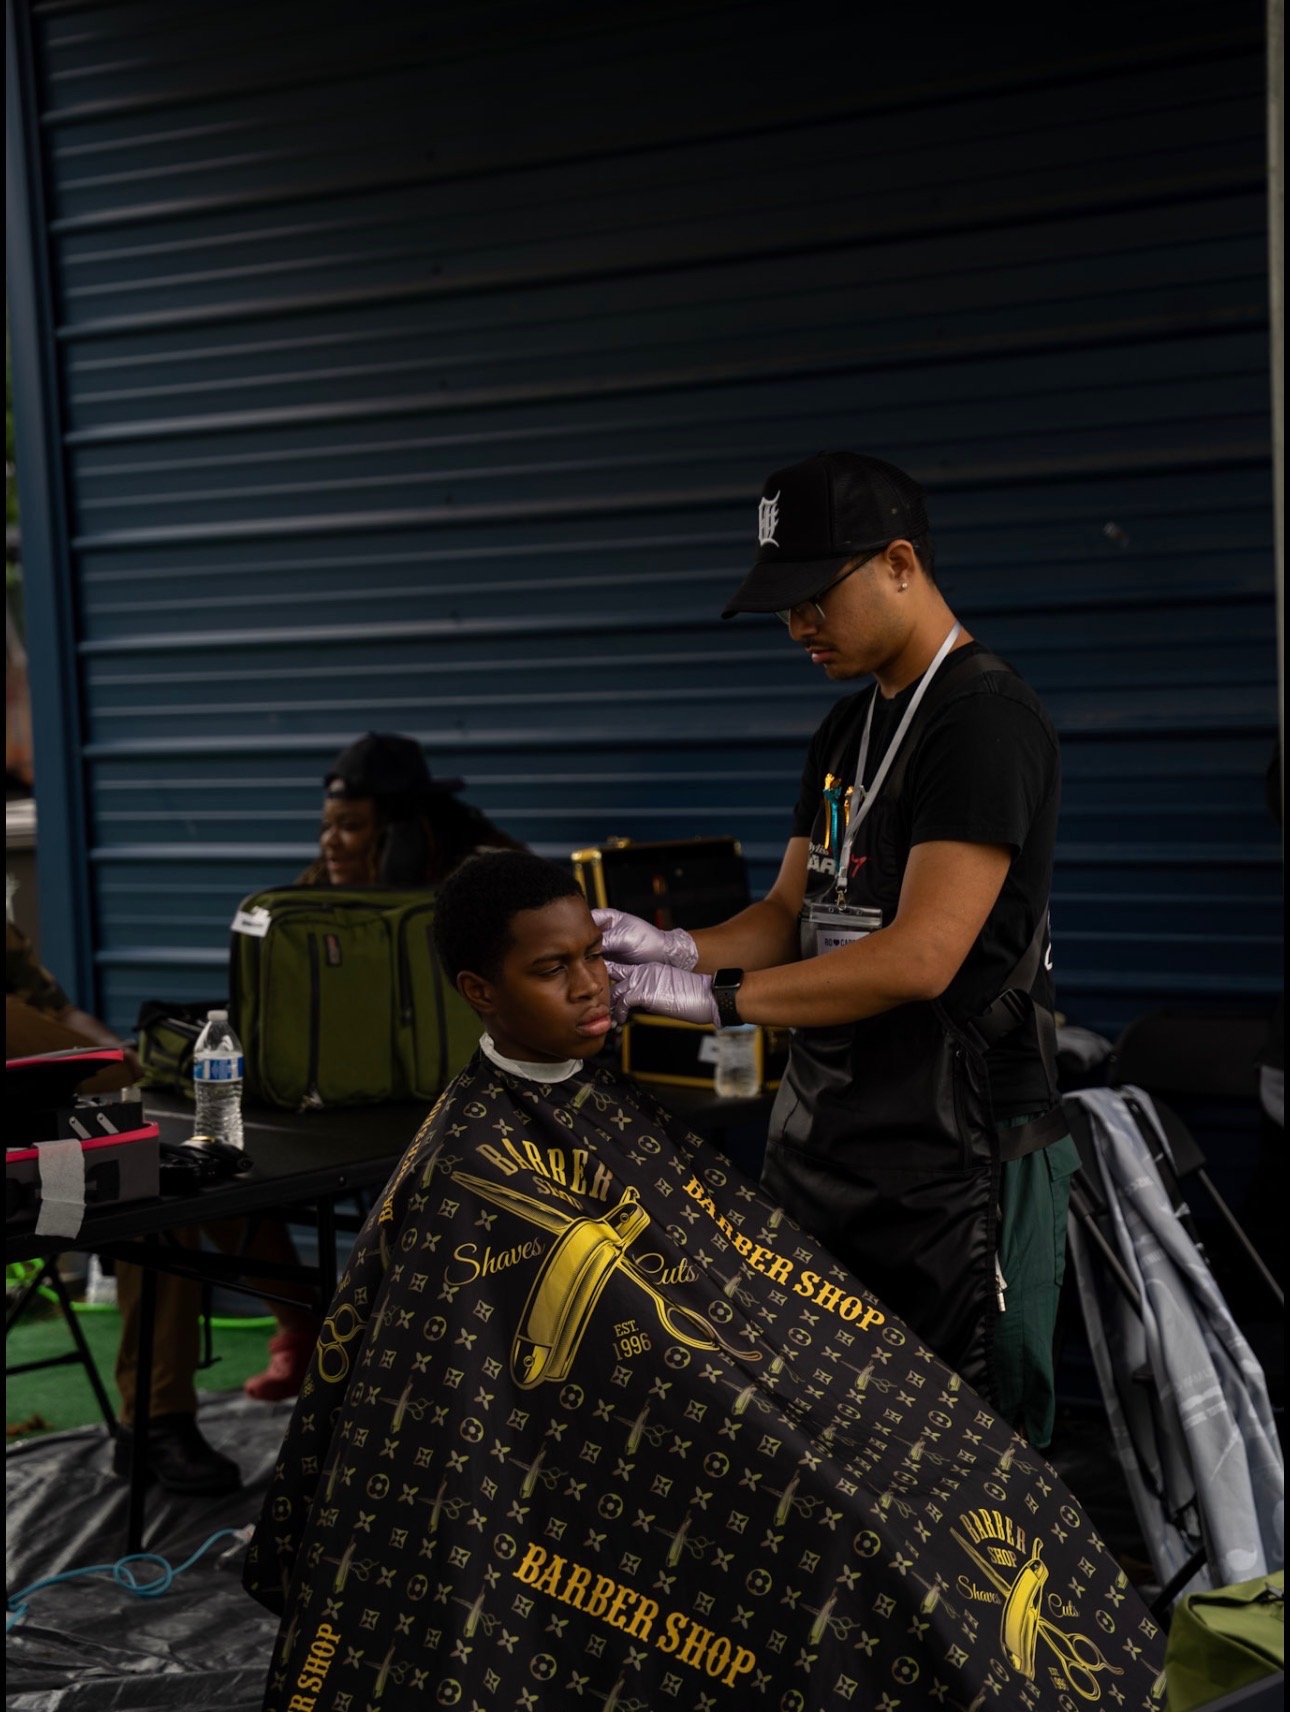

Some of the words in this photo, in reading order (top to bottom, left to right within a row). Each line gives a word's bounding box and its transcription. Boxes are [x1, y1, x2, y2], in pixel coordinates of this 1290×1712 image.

[475, 1138, 614, 1202] BARBER
[444, 1237, 546, 1287] Shaves
[632, 1252, 701, 1286] Cuts
[682, 1174, 794, 1286] BARBER
[792, 1270, 886, 1332] SHOP
[612, 1333, 652, 1361] 1996
[959, 1508, 1027, 1555] BARBER
[987, 1545, 1018, 1569] SHOP
[512, 1541, 660, 1643] BARBER
[655, 1611, 757, 1689] SHOP
[1046, 1592, 1080, 1619] Cuts
[297, 1623, 342, 1694] SHOP
